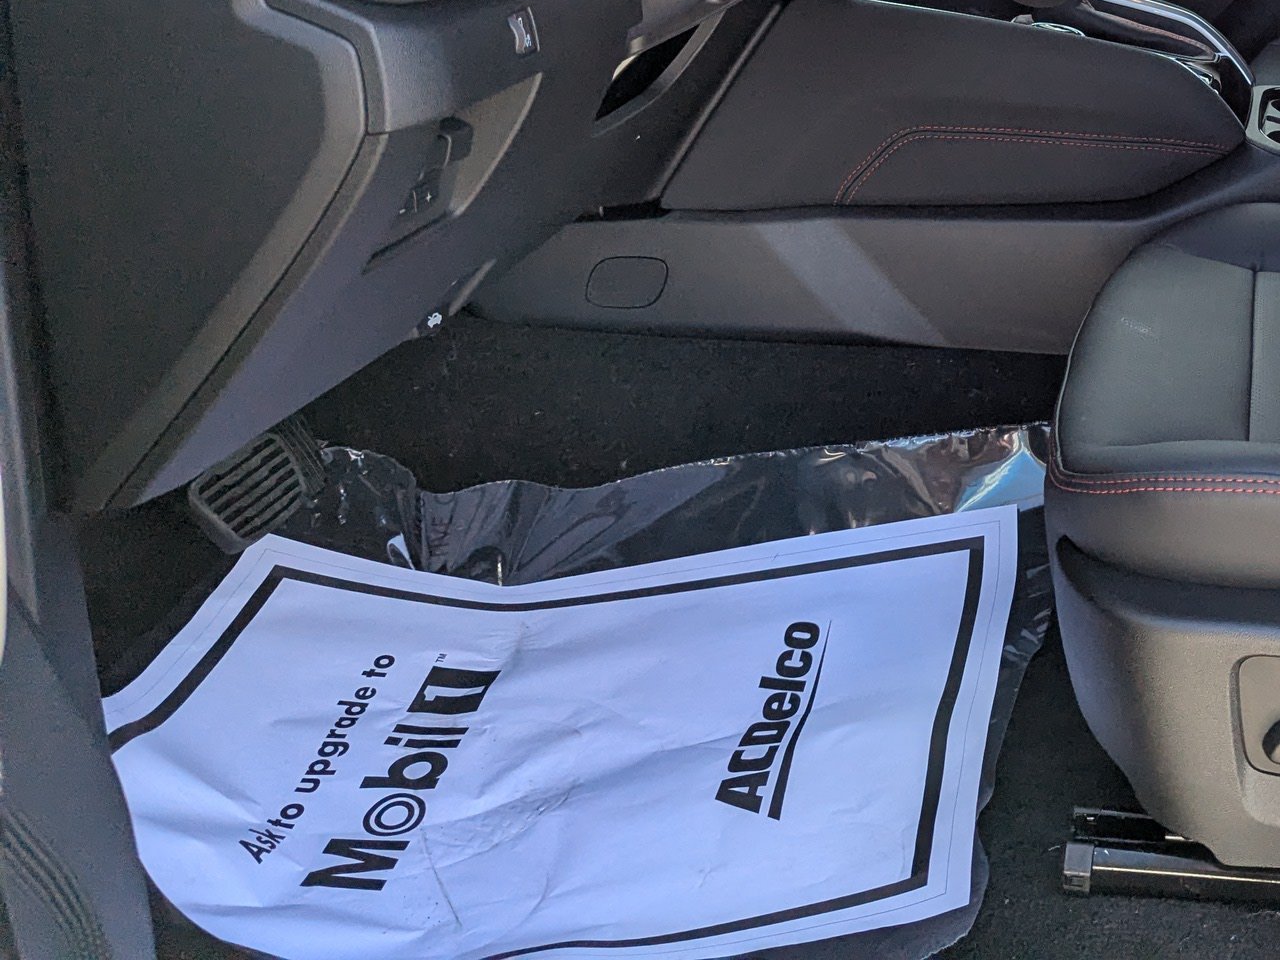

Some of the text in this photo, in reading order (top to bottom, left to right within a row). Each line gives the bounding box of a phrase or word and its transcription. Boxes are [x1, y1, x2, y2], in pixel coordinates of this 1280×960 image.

[238, 654, 396, 864] Ask to upgrade to
[299, 723, 470, 891] Mobil
[715, 621, 820, 814] ACDelco
